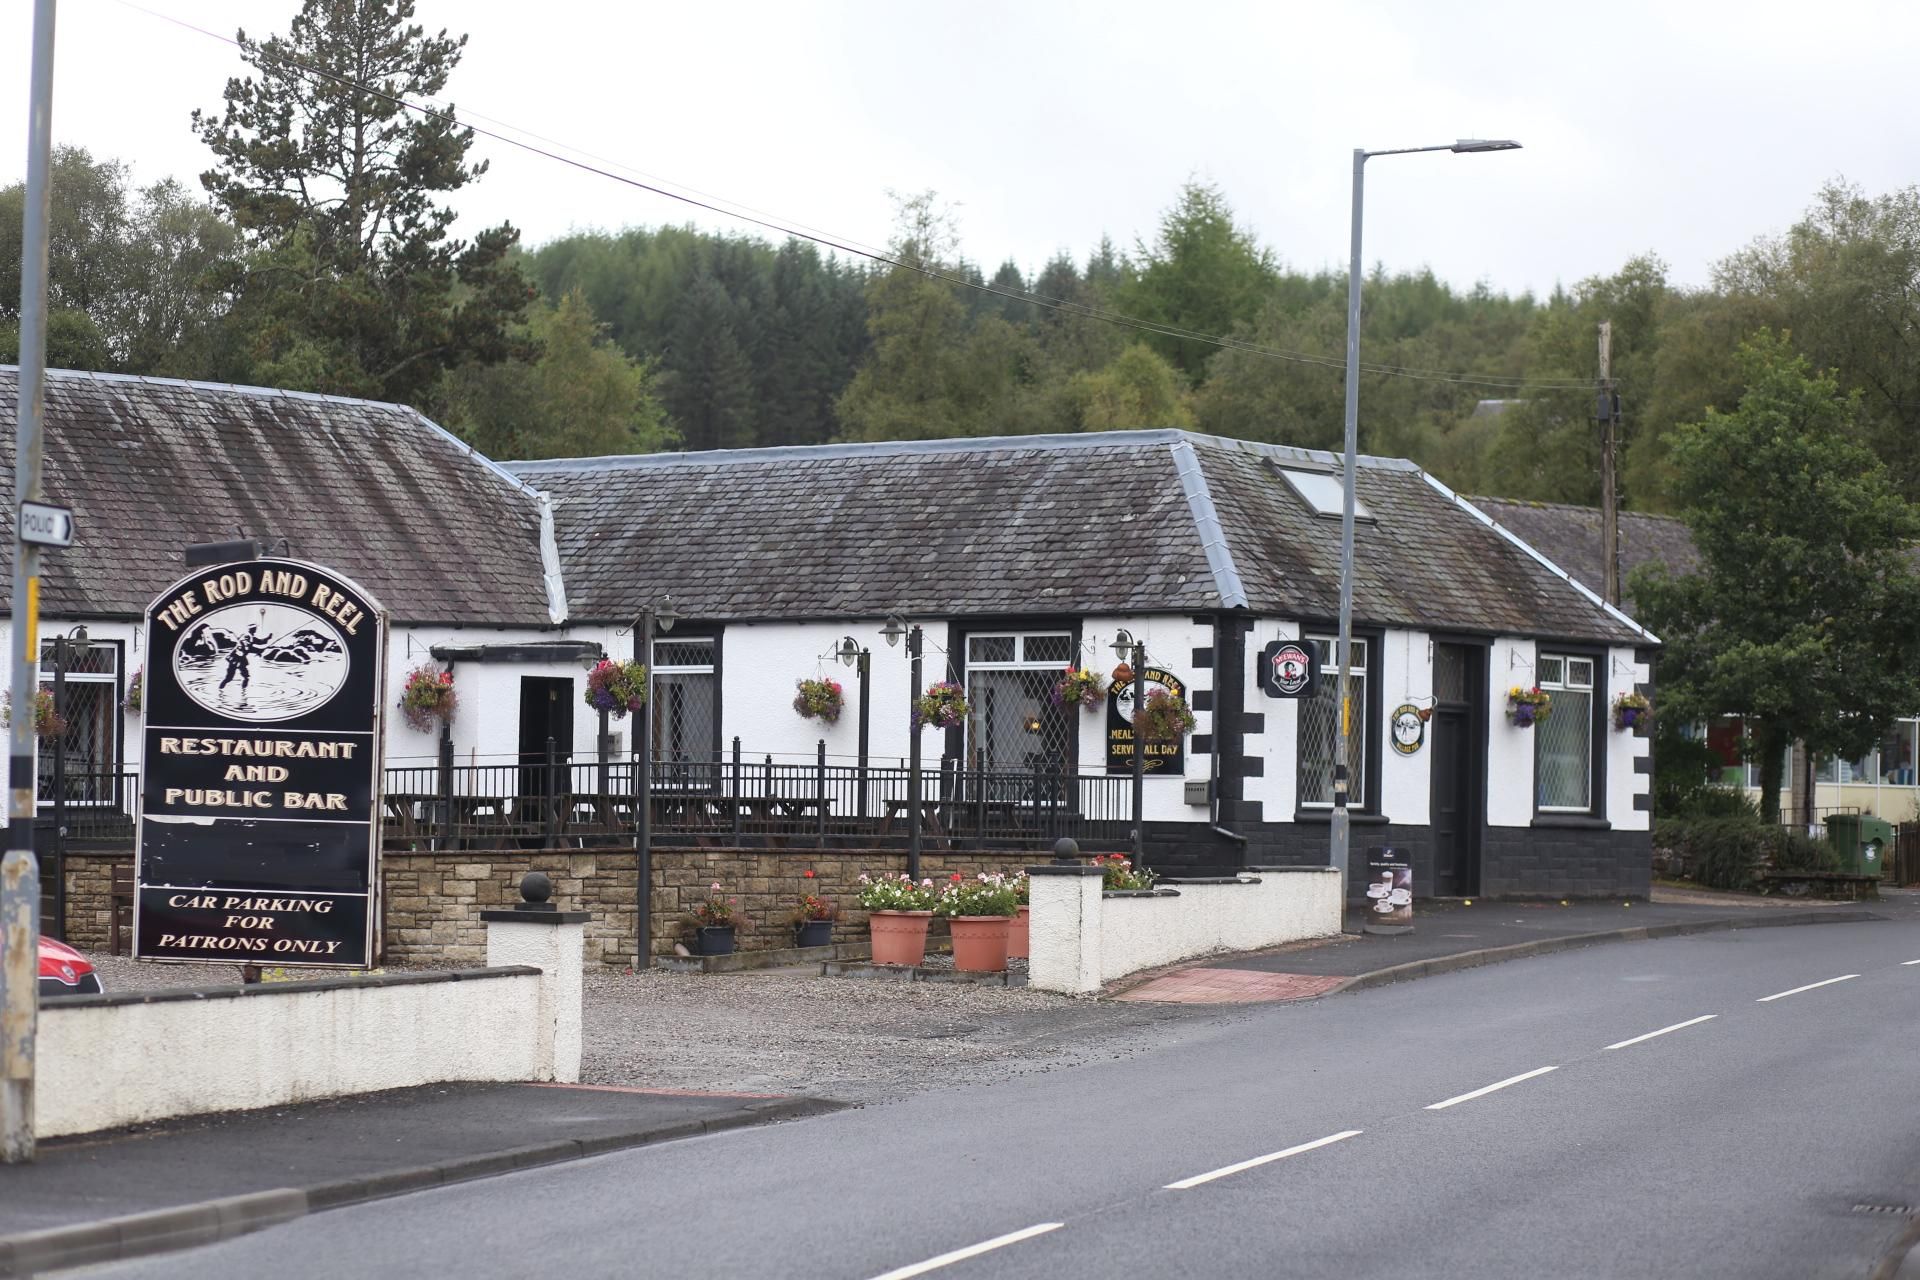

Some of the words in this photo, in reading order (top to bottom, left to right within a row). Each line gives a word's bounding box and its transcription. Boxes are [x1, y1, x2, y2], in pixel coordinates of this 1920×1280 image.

[157, 590, 203, 631] THE
[203, 571, 253, 604] ROD
[259, 569, 309, 599] AND
[311, 583, 365, 636] REEL
[1111, 680, 1127, 694] THE
[1144, 670, 1160, 680] AND
[160, 737, 358, 759] RESTAURANT
[1144, 744, 1159, 755] ALL
[1161, 744, 1178, 755] DAY
[223, 764, 289, 783] AND
[165, 788, 274, 807] PUBLIC
[283, 792, 348, 811] BAR
[168, 894, 217, 909] CAR
[223, 896, 333, 914] PARKING
[223, 915, 275, 930] FOR
[158, 934, 268, 951] PATRONS
[273, 938, 342, 954] ONLY
